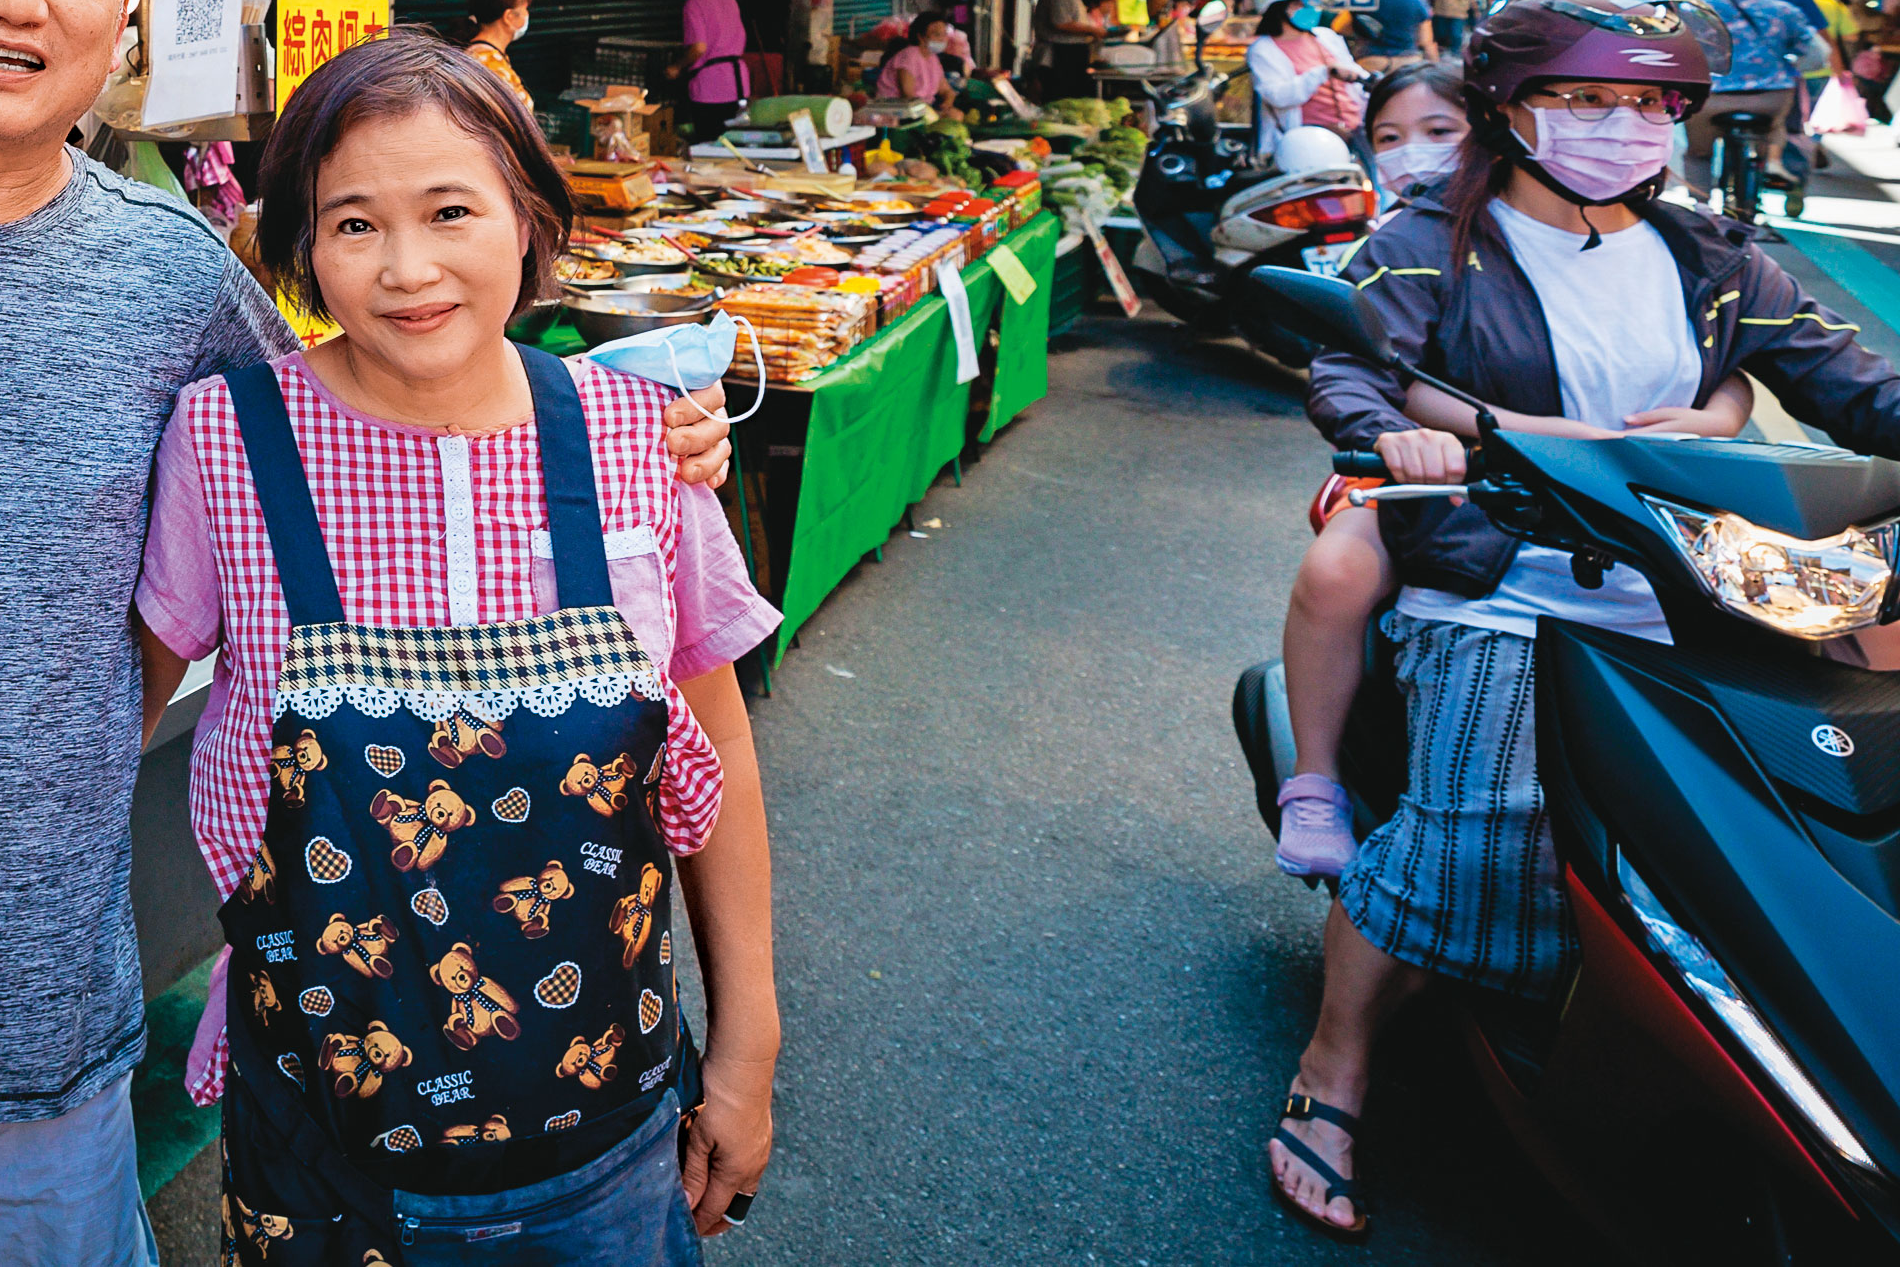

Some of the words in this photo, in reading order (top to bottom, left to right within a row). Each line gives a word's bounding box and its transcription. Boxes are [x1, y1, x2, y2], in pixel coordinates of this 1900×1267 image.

[583, 857, 617, 879] BEAR
[256, 929, 295, 951] CLASSIC
[265, 946, 298, 963] BEAR
[417, 1069, 473, 1096] CLASSIC
[431, 1086, 476, 1107] BEAR
